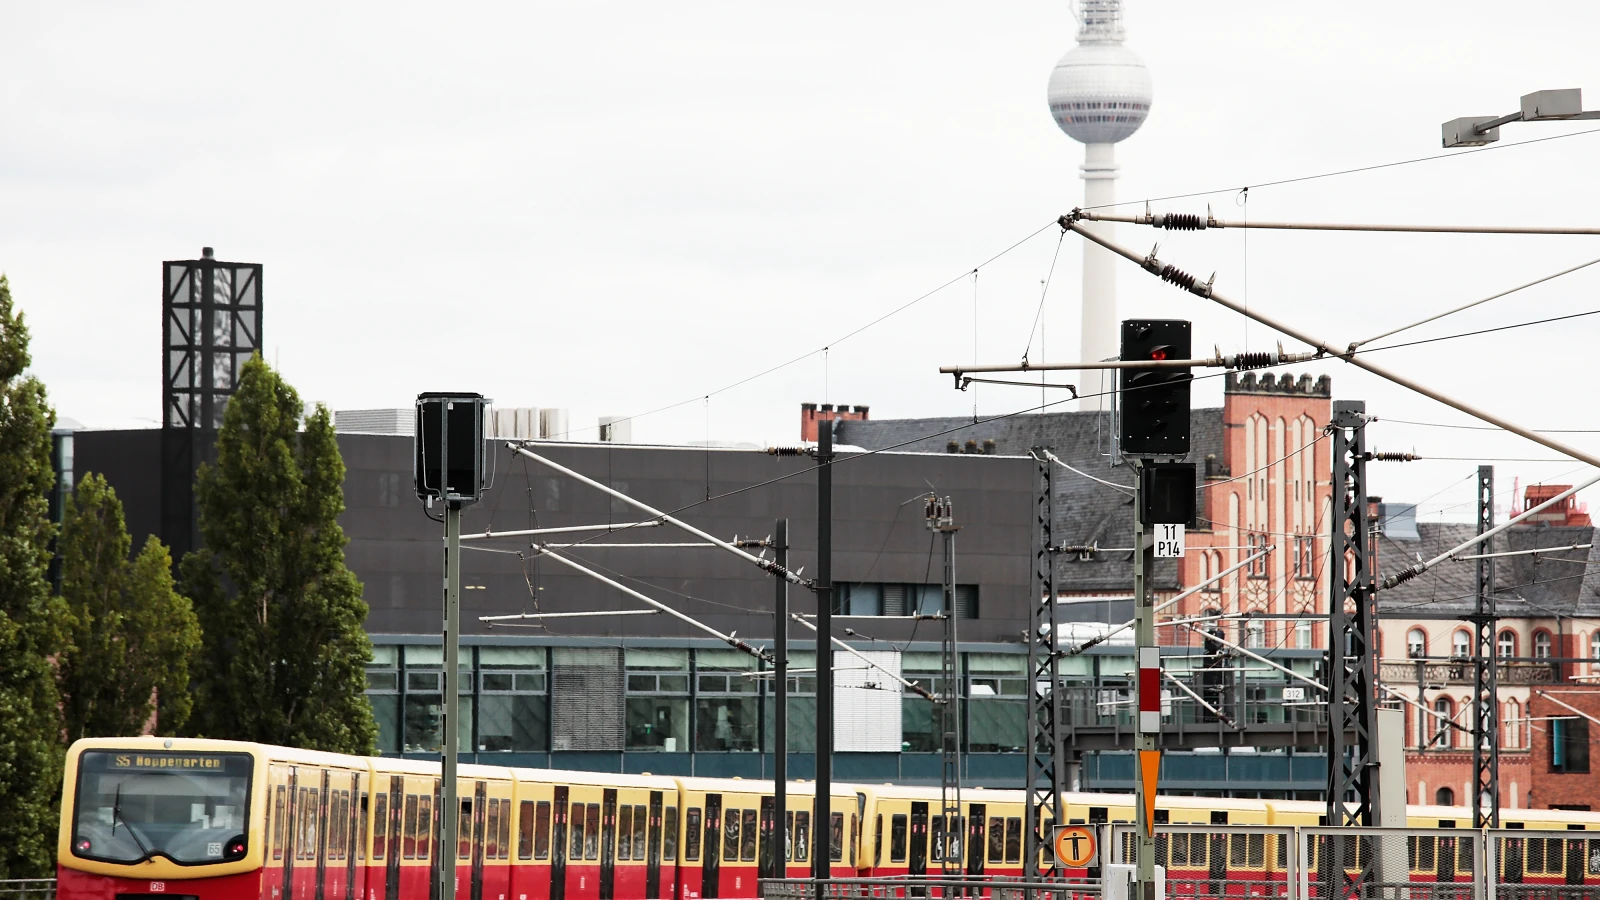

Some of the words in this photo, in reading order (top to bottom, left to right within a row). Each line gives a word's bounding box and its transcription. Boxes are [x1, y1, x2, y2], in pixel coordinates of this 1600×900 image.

[1164, 525, 1175, 540] 11
[1286, 689, 1301, 699] 312
[116, 755, 131, 767] S5
[209, 844, 220, 854] 65
[151, 882, 164, 891] DB
